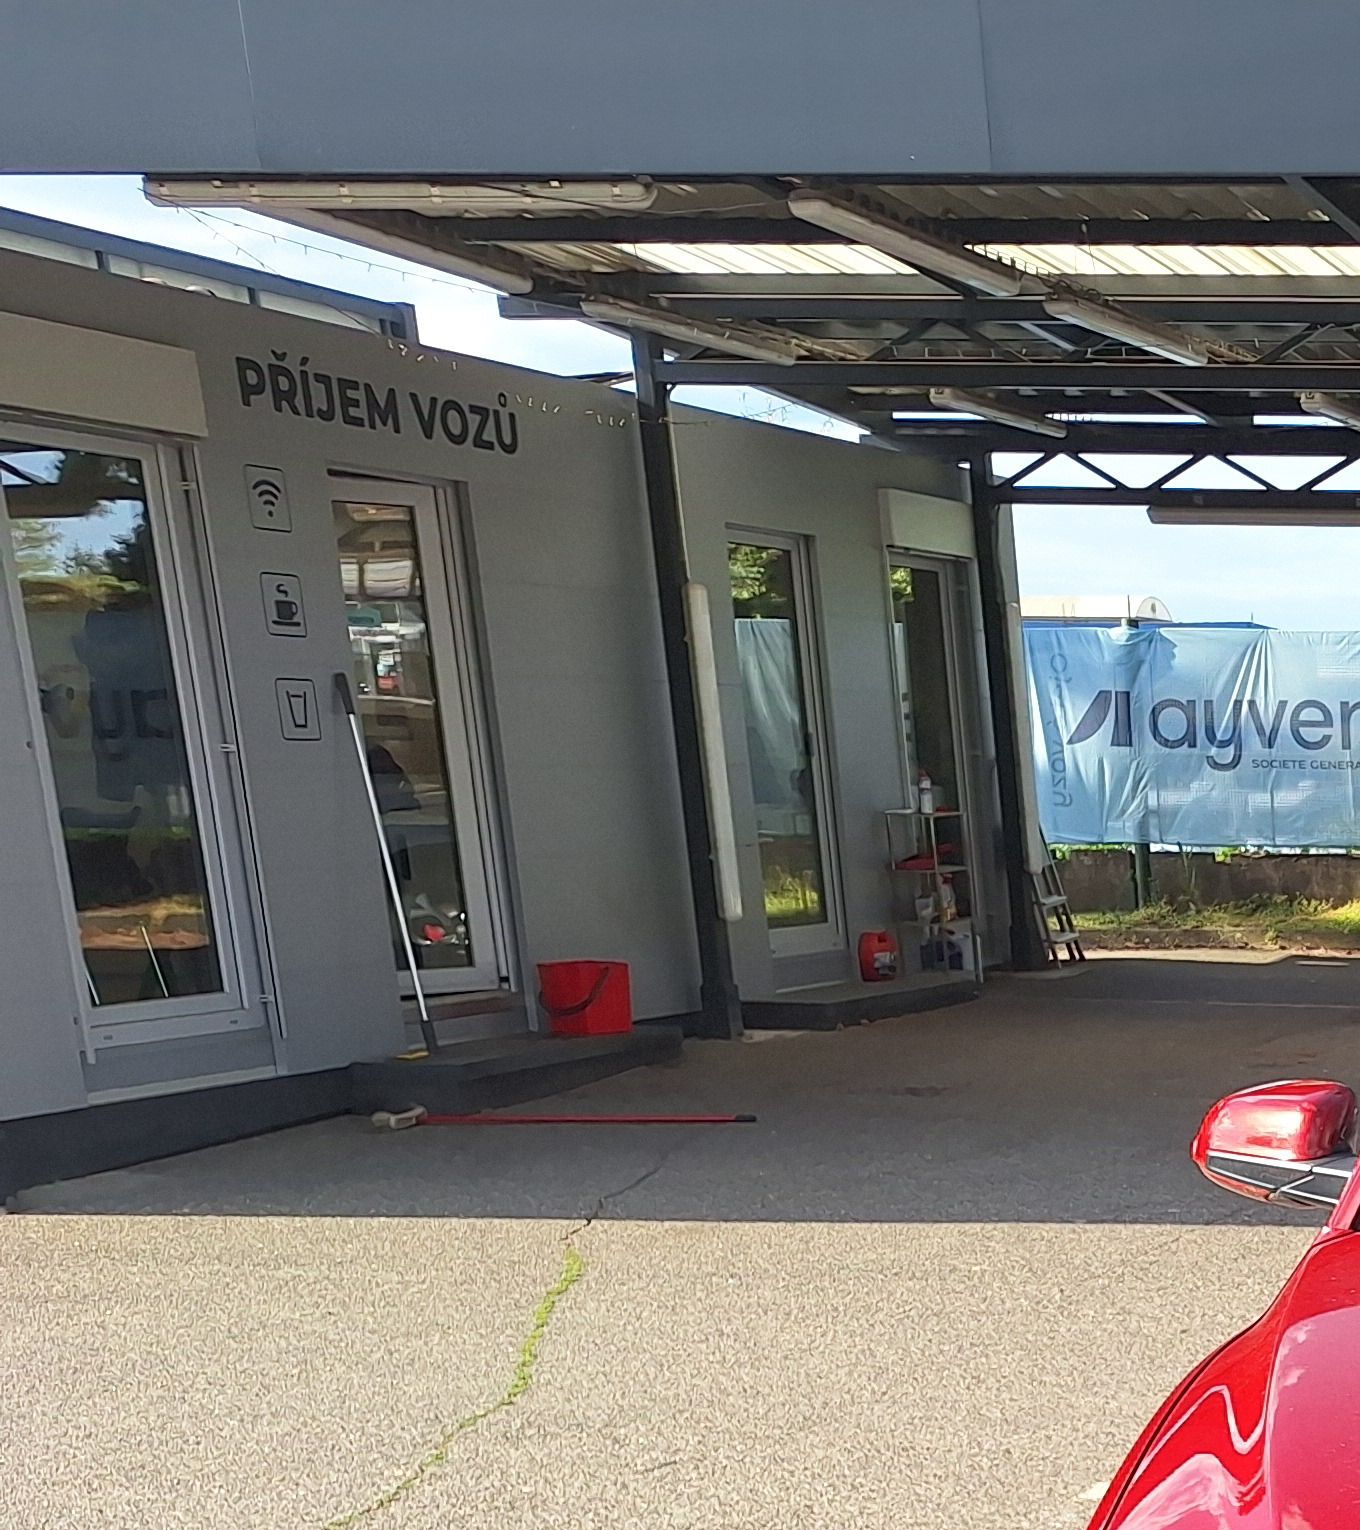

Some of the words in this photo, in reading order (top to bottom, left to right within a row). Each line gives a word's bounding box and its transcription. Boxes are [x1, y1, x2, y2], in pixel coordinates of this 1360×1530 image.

[235, 349, 401, 435] PŘÍJEM
[408, 391, 519, 455] VOZŮ
[1251, 759, 1307, 770] SOCIETE
